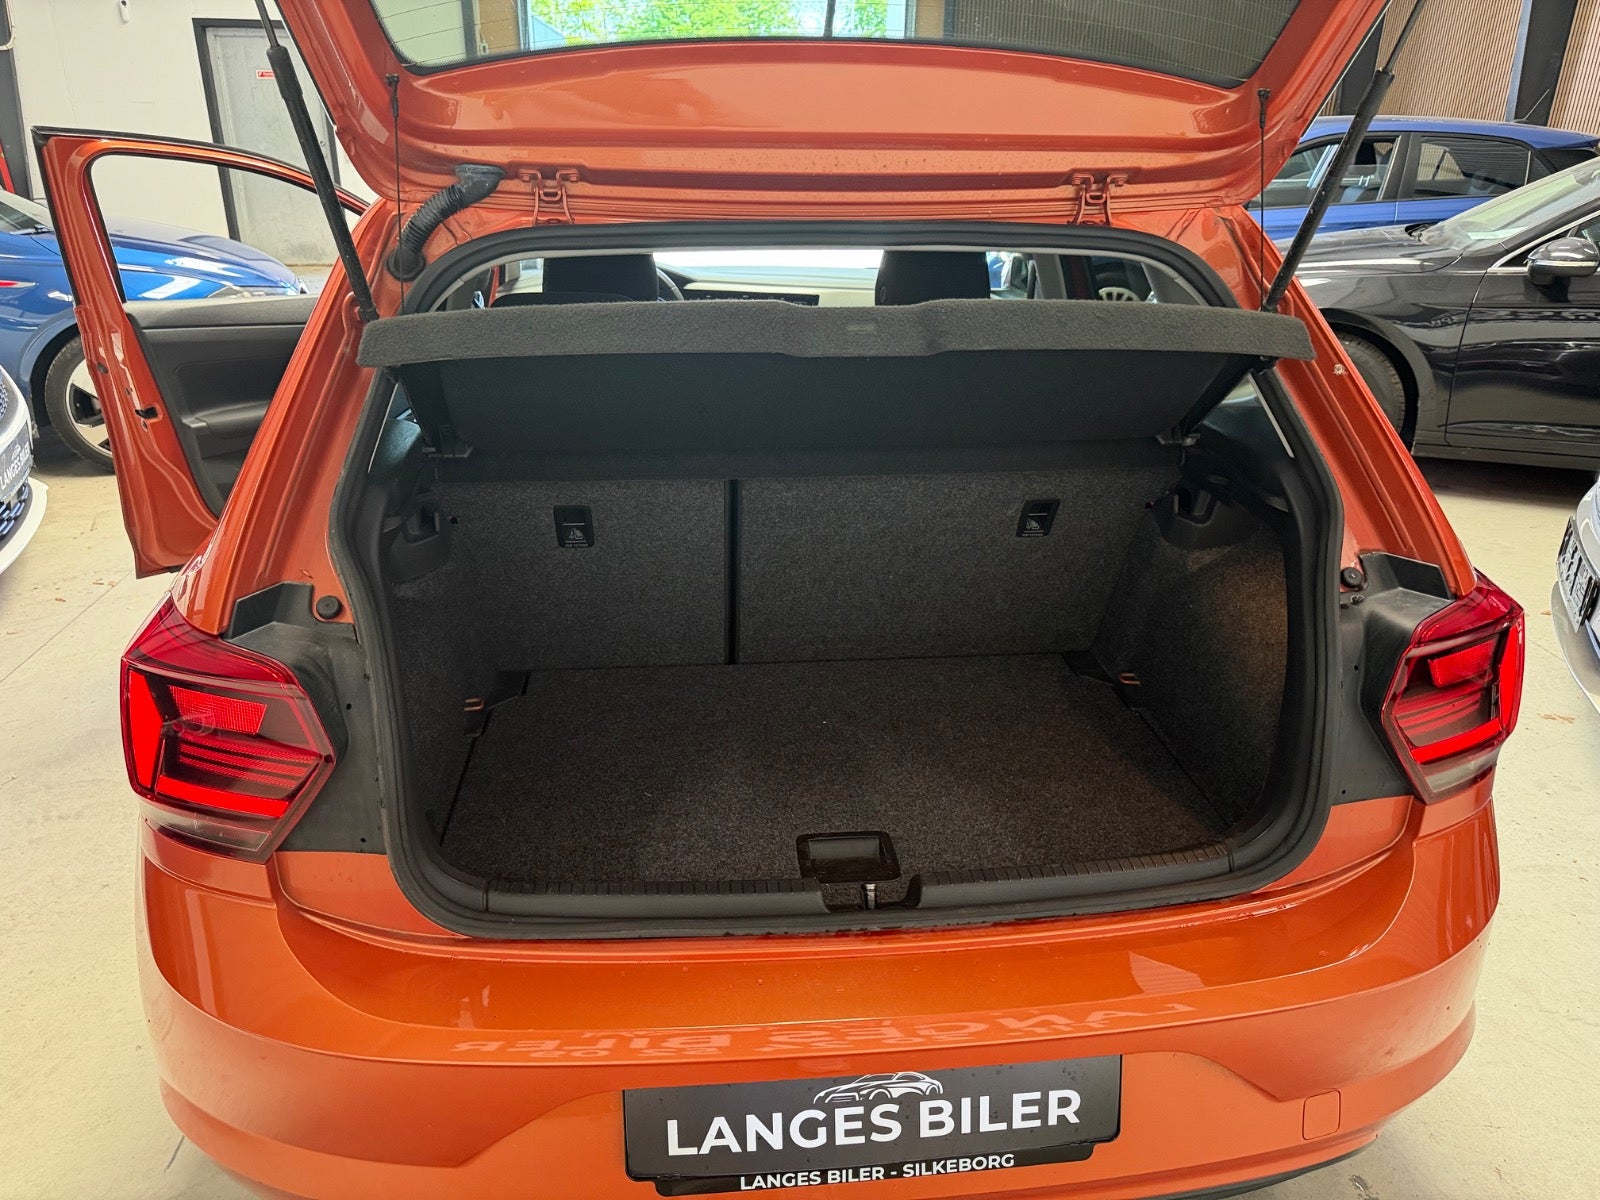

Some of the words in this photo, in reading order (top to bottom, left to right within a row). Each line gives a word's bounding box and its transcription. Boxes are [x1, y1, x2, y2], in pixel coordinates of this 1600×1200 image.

[667, 1104, 902, 1156] LANGES
[919, 1089, 1081, 1139] BILER
[740, 1171, 822, 1191] LANGES
[827, 1166, 884, 1184] BILER
[903, 1153, 1015, 1178] SILKEBORG
